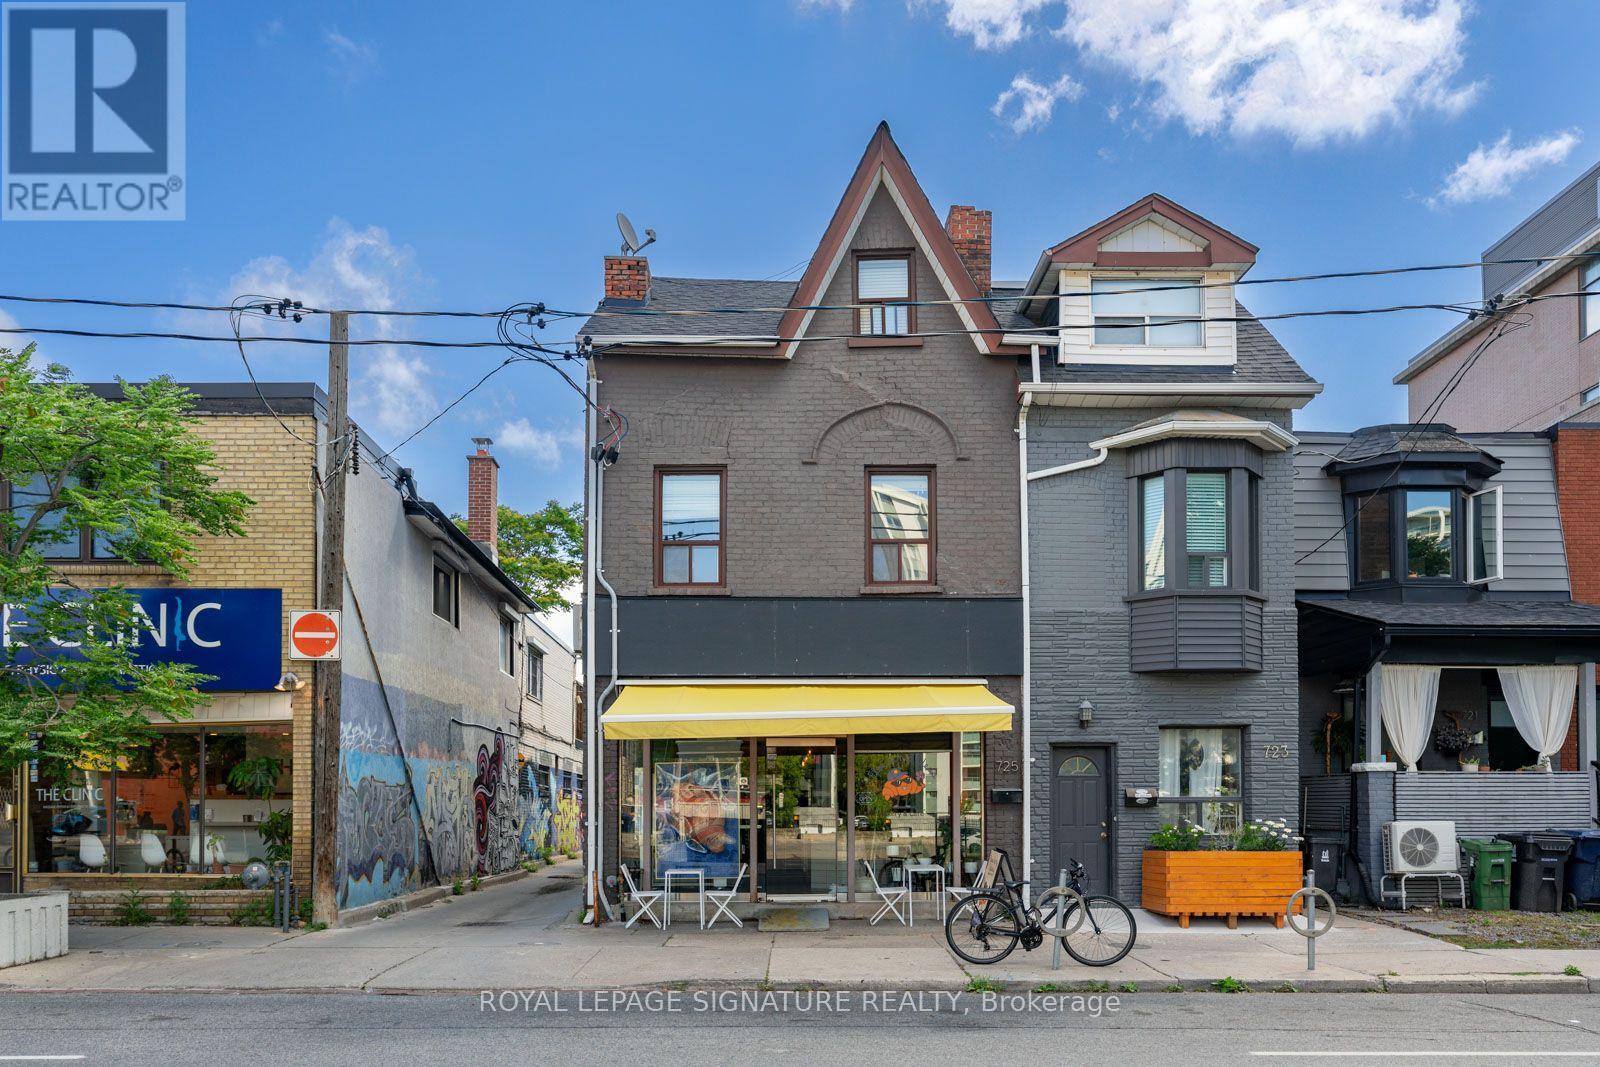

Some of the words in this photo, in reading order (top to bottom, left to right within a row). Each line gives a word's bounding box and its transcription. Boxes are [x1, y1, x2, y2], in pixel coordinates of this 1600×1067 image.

[1263, 744, 1289, 759] 723
[995, 760, 1019, 772] 725
[36, 787, 60, 802] THE
